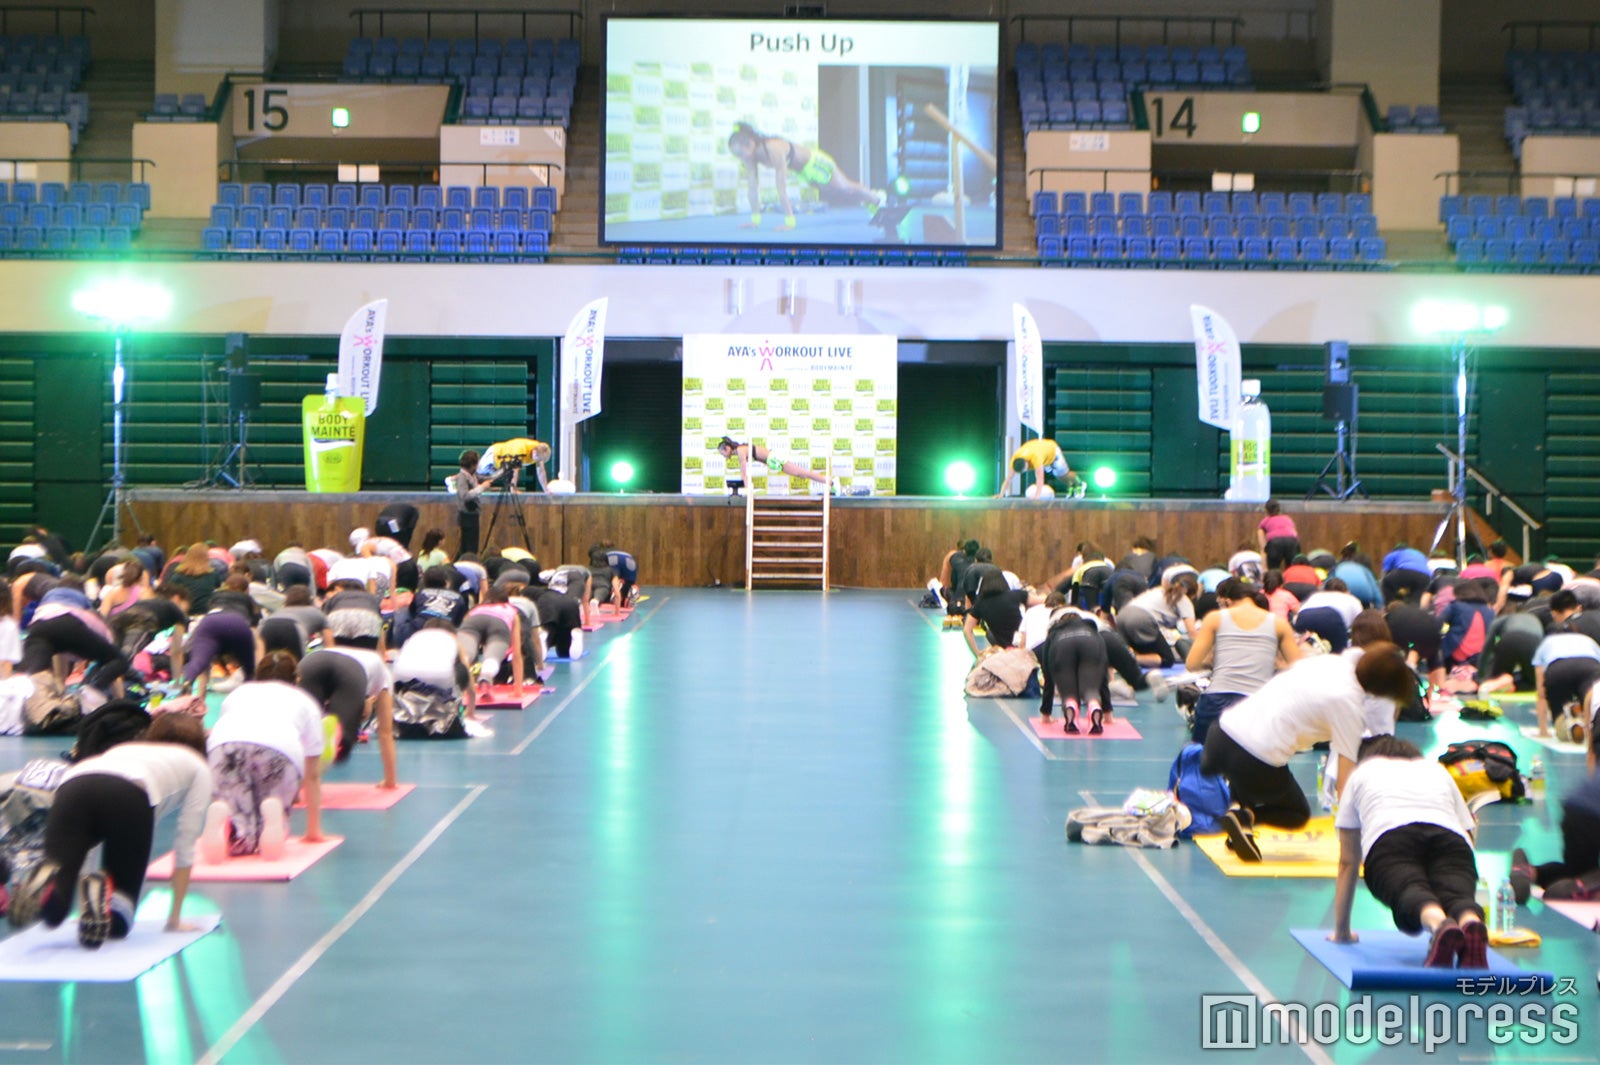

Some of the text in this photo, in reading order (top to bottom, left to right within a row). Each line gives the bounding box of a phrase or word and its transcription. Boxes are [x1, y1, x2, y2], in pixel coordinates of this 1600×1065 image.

[750, 32, 854, 57] Push Up
[244, 89, 289, 131] 15
[1151, 96, 1198, 138] 14
[727, 346, 757, 357] AYA's
[827, 346, 853, 358] LIVE
[318, 414, 348, 425] BODY
